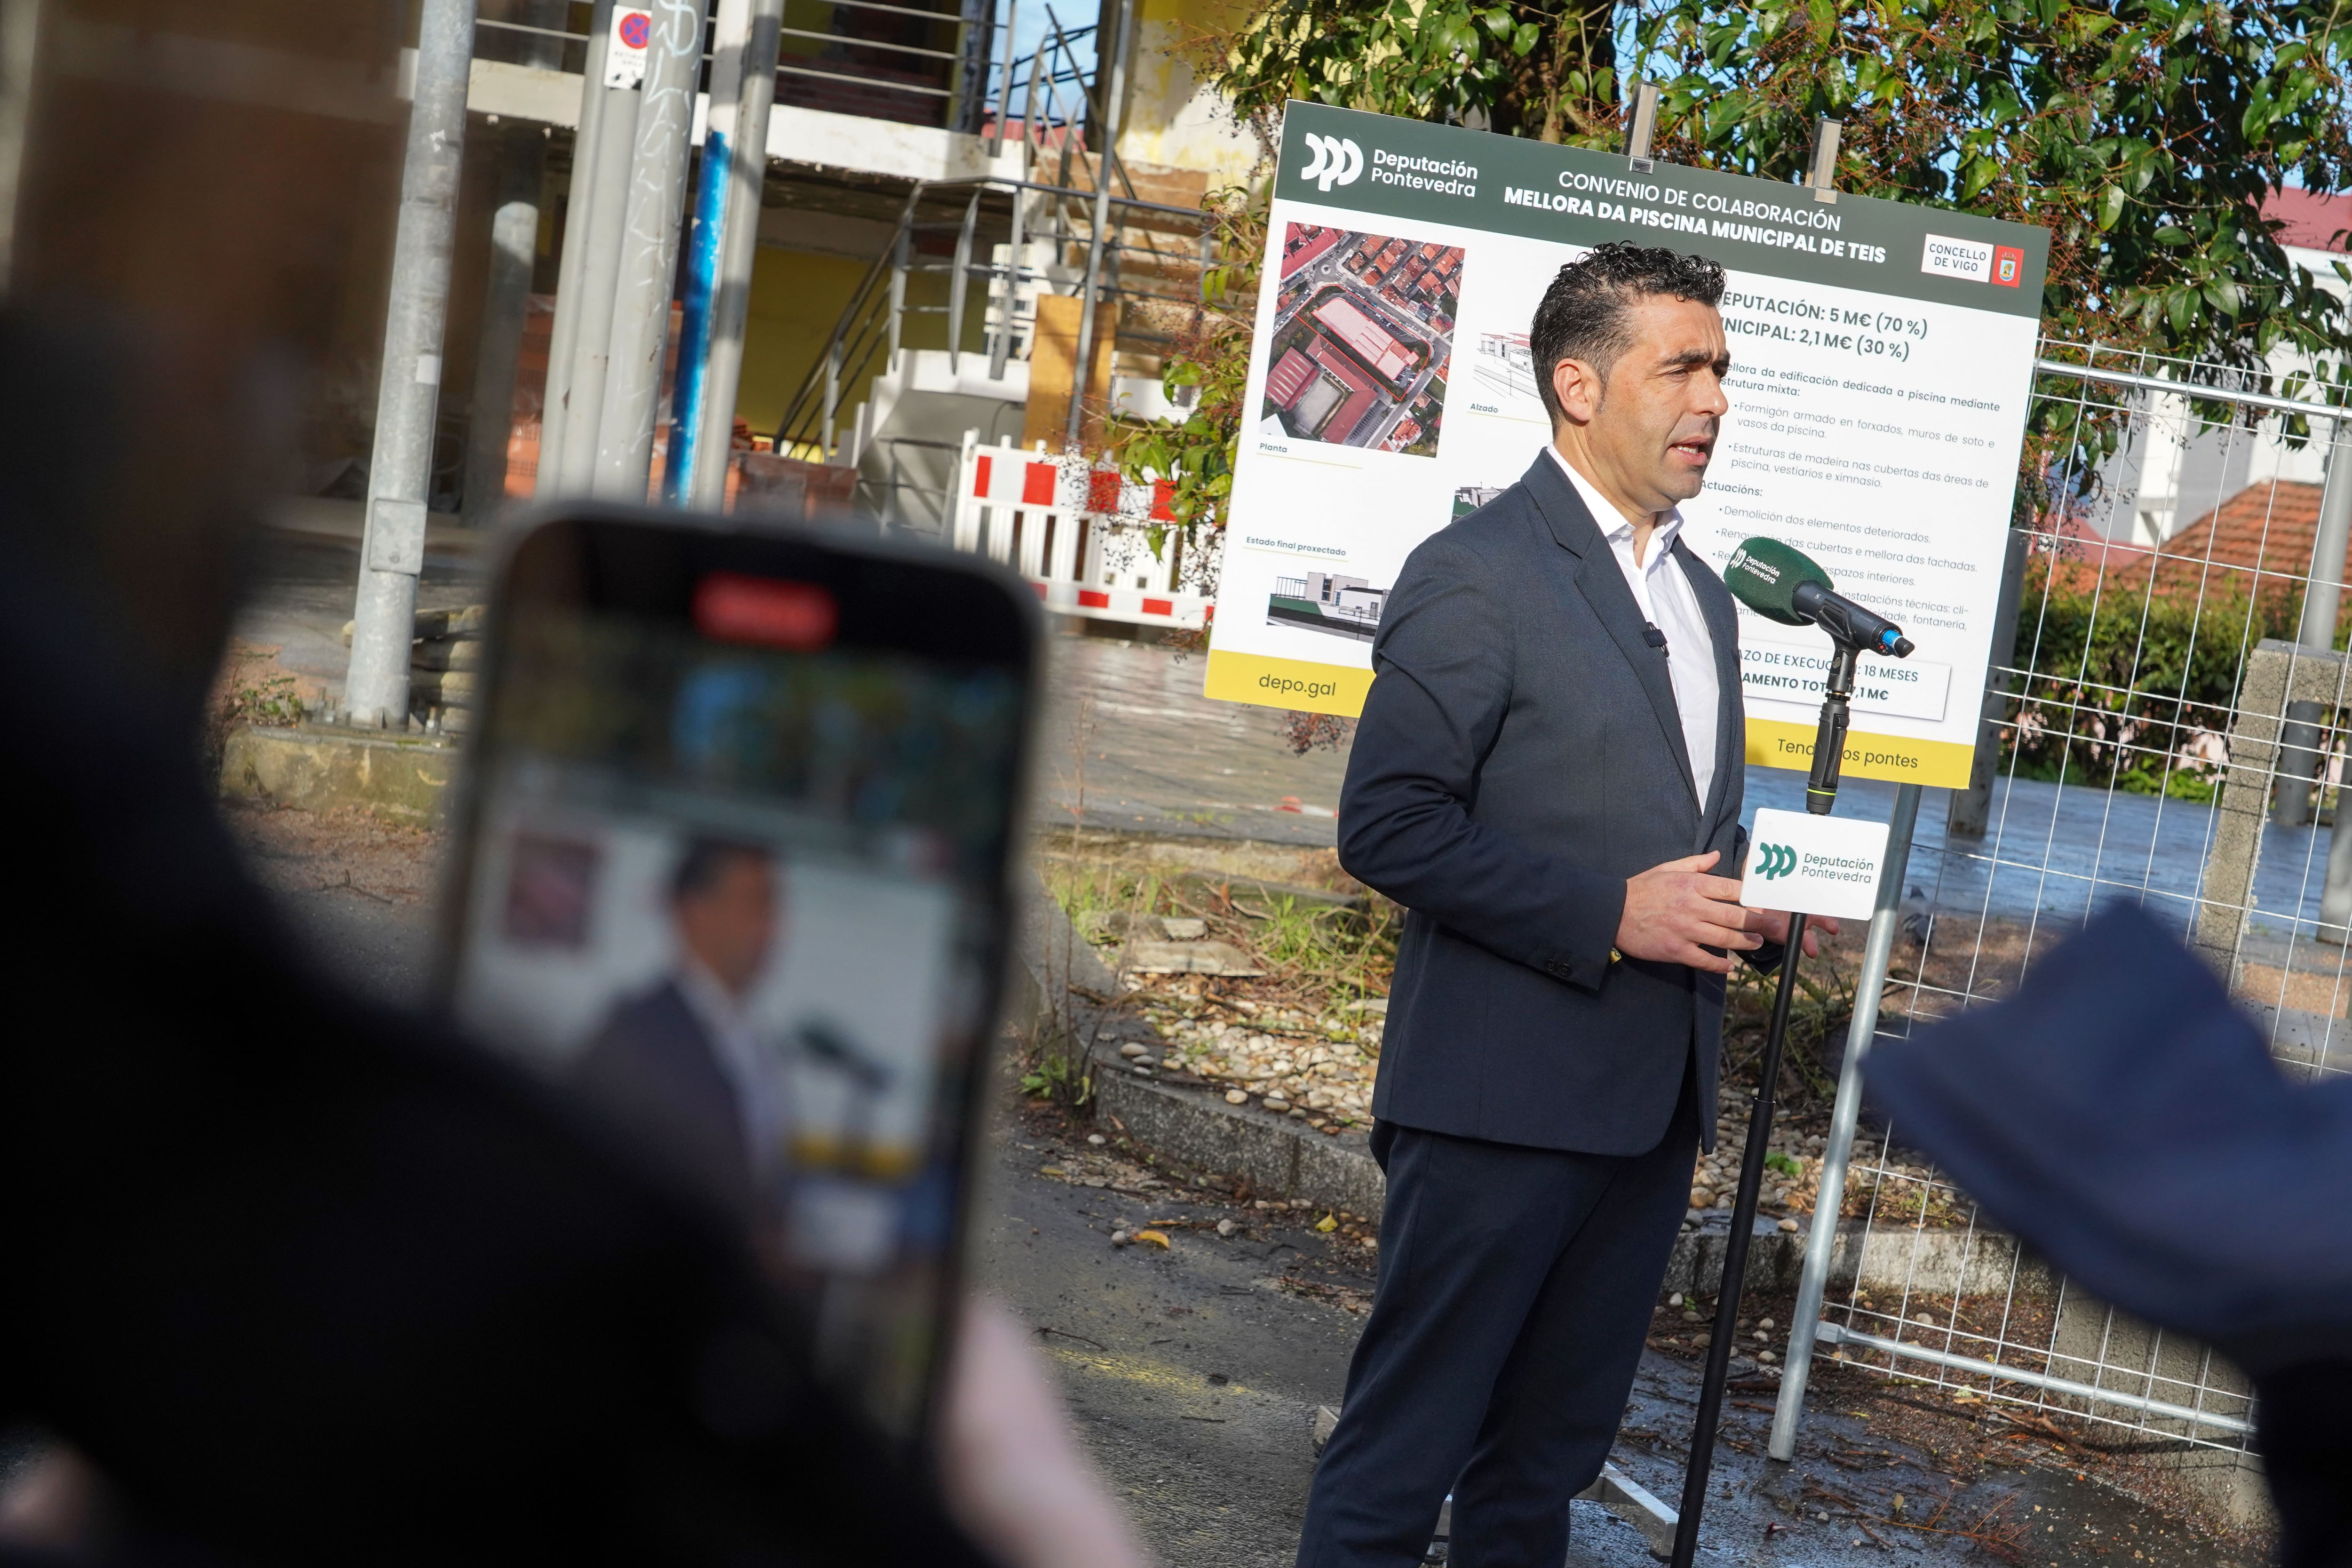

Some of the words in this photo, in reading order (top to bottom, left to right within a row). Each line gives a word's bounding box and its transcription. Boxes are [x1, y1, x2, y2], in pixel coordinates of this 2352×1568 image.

[1374, 149, 1478, 179] Deputación
[1371, 167, 1476, 198] Pontevedra
[1559, 171, 1660, 201] CONVENIO
[1664, 188, 1688, 207] DE
[1692, 193, 1841, 231] COLABORACIÓN
[1504, 186, 1593, 216] MELLORA
[1597, 202, 1626, 222] DA
[1629, 207, 1708, 235] PISCINA
[1711, 220, 1817, 253] MUNICIPAL
[1820, 238, 1845, 257] DE
[1849, 242, 1886, 263] TEIS
[1929, 244, 1986, 261] CONCELLO
[1934, 256, 1948, 267] DE
[1953, 259, 1978, 271] VIGO
[1723, 291, 1825, 320] EPUTACIÓN:
[1830, 308, 1839, 322] 5
[1843, 310, 1872, 327] M€
[1876, 312, 1902, 333] (70
[1907, 318, 1927, 340] %)
[1721, 317, 1796, 341] NICIPAL:
[1799, 329, 1820, 346] 2,1
[1824, 333, 1852, 350] M€
[1857, 334, 1884, 356] (30
[1889, 341, 1909, 362] %)
[1721, 378, 1764, 390] strutura
[1767, 384, 1800, 396] mixta:
[1727, 362, 1756, 374] ellora
[1761, 367, 1775, 377] da
[1780, 371, 1838, 387] edificación
[1843, 380, 1892, 395] dedicada
[1908, 390, 1946, 403] piscina
[1950, 398, 2000, 411] mediante
[1470, 403, 1498, 413] Alzado
[1738, 418, 1768, 430] vasos
[1771, 422, 1784, 432] da
[1787, 425, 1826, 438] piscina.
[1740, 402, 1788, 418] Formigón
[1794, 412, 1836, 424] armado
[1858, 419, 1903, 435] forxados,
[1908, 429, 1940, 440] muros
[1945, 433, 1958, 443] de
[1962, 437, 1984, 446] soto
[1260, 443, 1287, 453] Planta
[1731, 458, 1770, 472] piscina,
[1774, 465, 1823, 479] vestiarios
[1835, 473, 1882, 487] ximnasio.
[1733, 443, 1785, 459] Estruturas
[1788, 451, 1802, 461] de
[1805, 455, 1849, 468] madeira
[1852, 462, 1871, 471] nas
[1874, 465, 1919, 478] cubertas
[1922, 471, 1941, 481] das
[1944, 475, 1972, 486] áreas
[1976, 478, 1988, 488] de
[1701, 480, 1763, 496] Actuacións:
[1724, 506, 1782, 522] Demolición
[1786, 515, 1804, 525] dos
[1807, 518, 1861, 533] elementos
[1864, 526, 1931, 543] deteriorados.
[1247, 536, 1275, 546] Estado
[1277, 540, 1296, 549] final
[1297, 545, 1346, 556] proxectado
[1785, 537, 1804, 549] das
[1807, 541, 1852, 555] cubertas
[1865, 549, 1903, 561] mellora
[1906, 554, 1925, 565] das
[1928, 557, 1977, 572] fachadas.
[1742, 562, 1776, 584] Pontevedra
[1745, 555, 1780, 578] Deputación
[1823, 566, 1864, 579] espazos
[1867, 571, 1915, 586] interiores.
[1842, 589, 1902, 606] instalacións
[1906, 599, 1950, 613] técnicas:
[1953, 605, 1969, 614] cli-
[1913, 614, 1966, 630] fontanería,
[1764, 653, 1780, 664] DE
[1865, 665, 1876, 677] 18
[1879, 668, 1918, 682] MESES
[1259, 674, 1336, 698] depo.gal
[1742, 672, 1798, 689] AMENTO
[1867, 688, 1889, 700] M€
[1864, 752, 1918, 768] pontes
[1802, 866, 1871, 883] Pontevedra
[1804, 853, 1874, 873] Deputación
